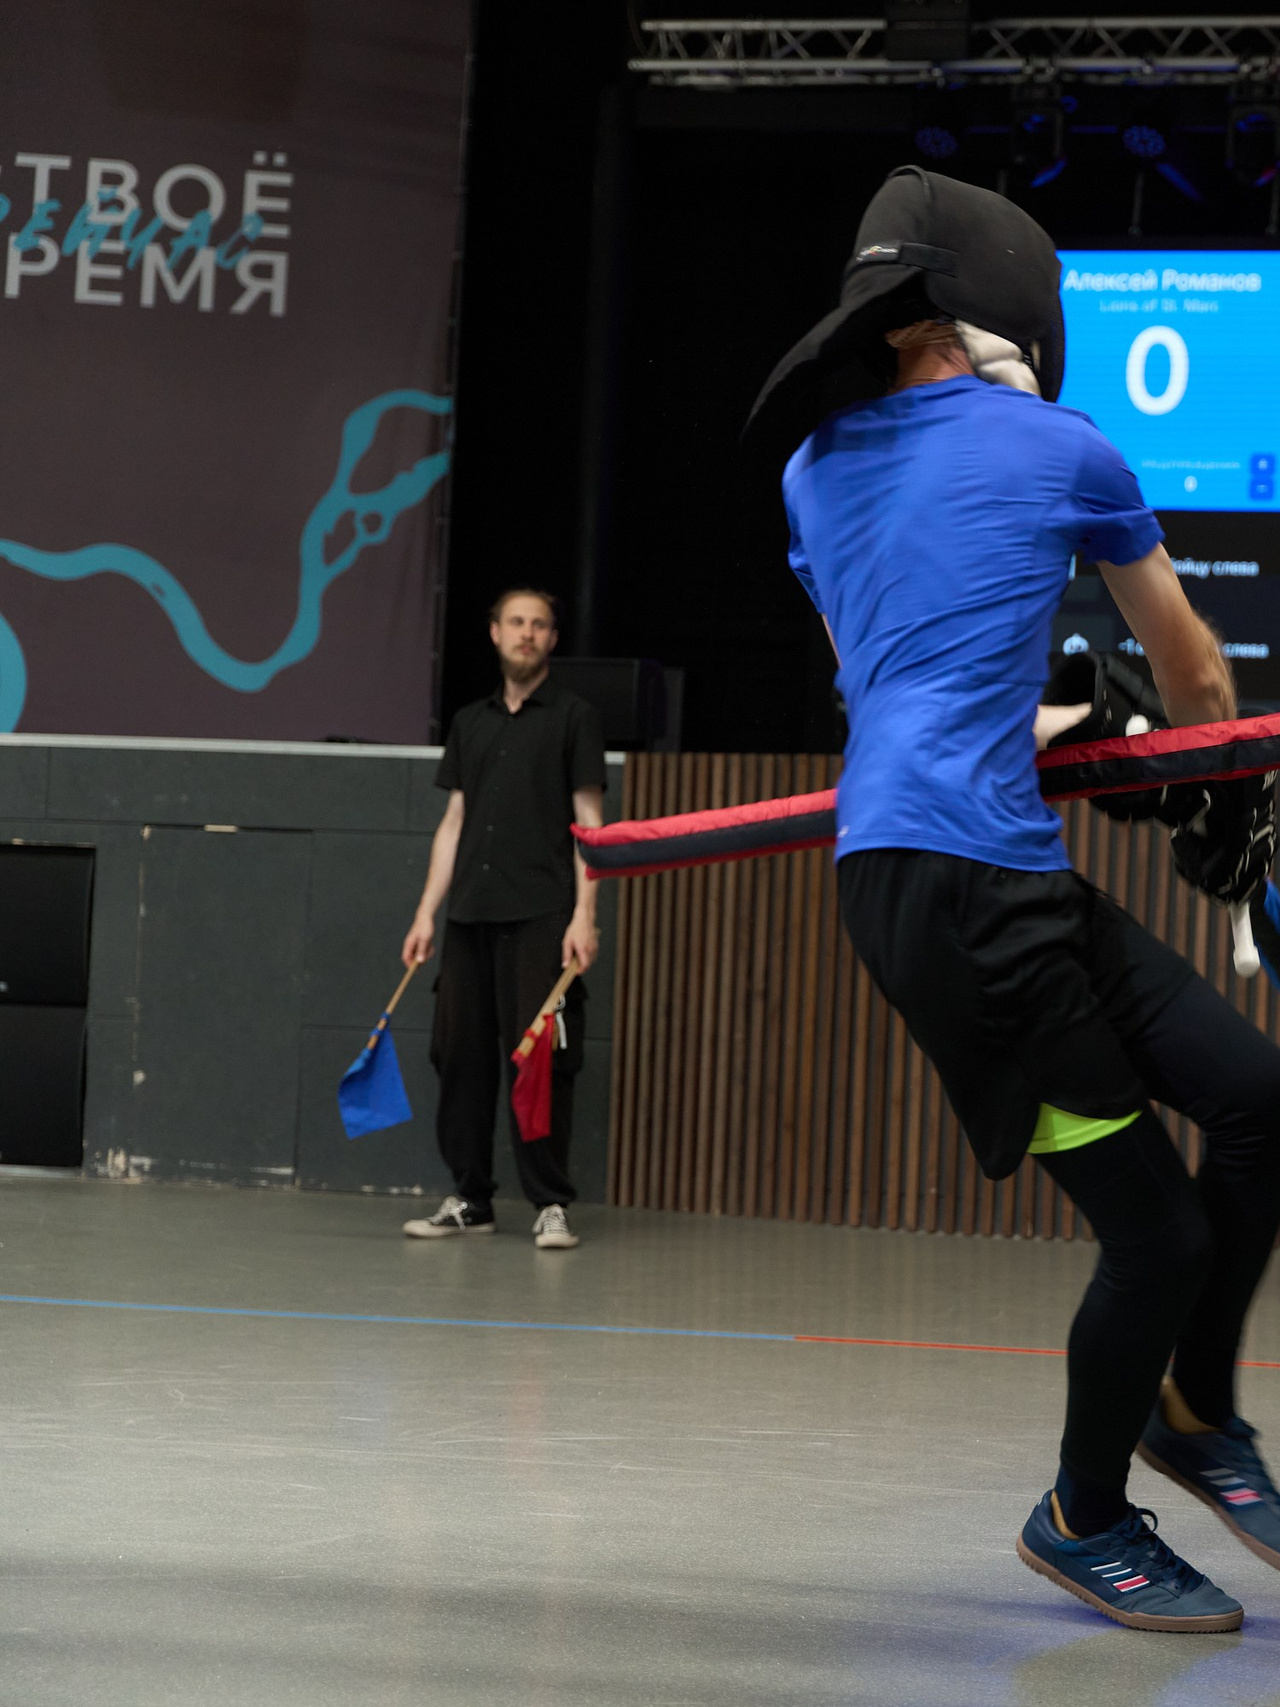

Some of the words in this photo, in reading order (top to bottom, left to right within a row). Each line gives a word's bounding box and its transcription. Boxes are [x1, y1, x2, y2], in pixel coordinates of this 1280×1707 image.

[1063, 268, 1159, 292] Алексей
[1162, 268, 1262, 292] Романов
[1126, 325, 1190, 416] 0
[1212, 560, 1260, 577] слева
